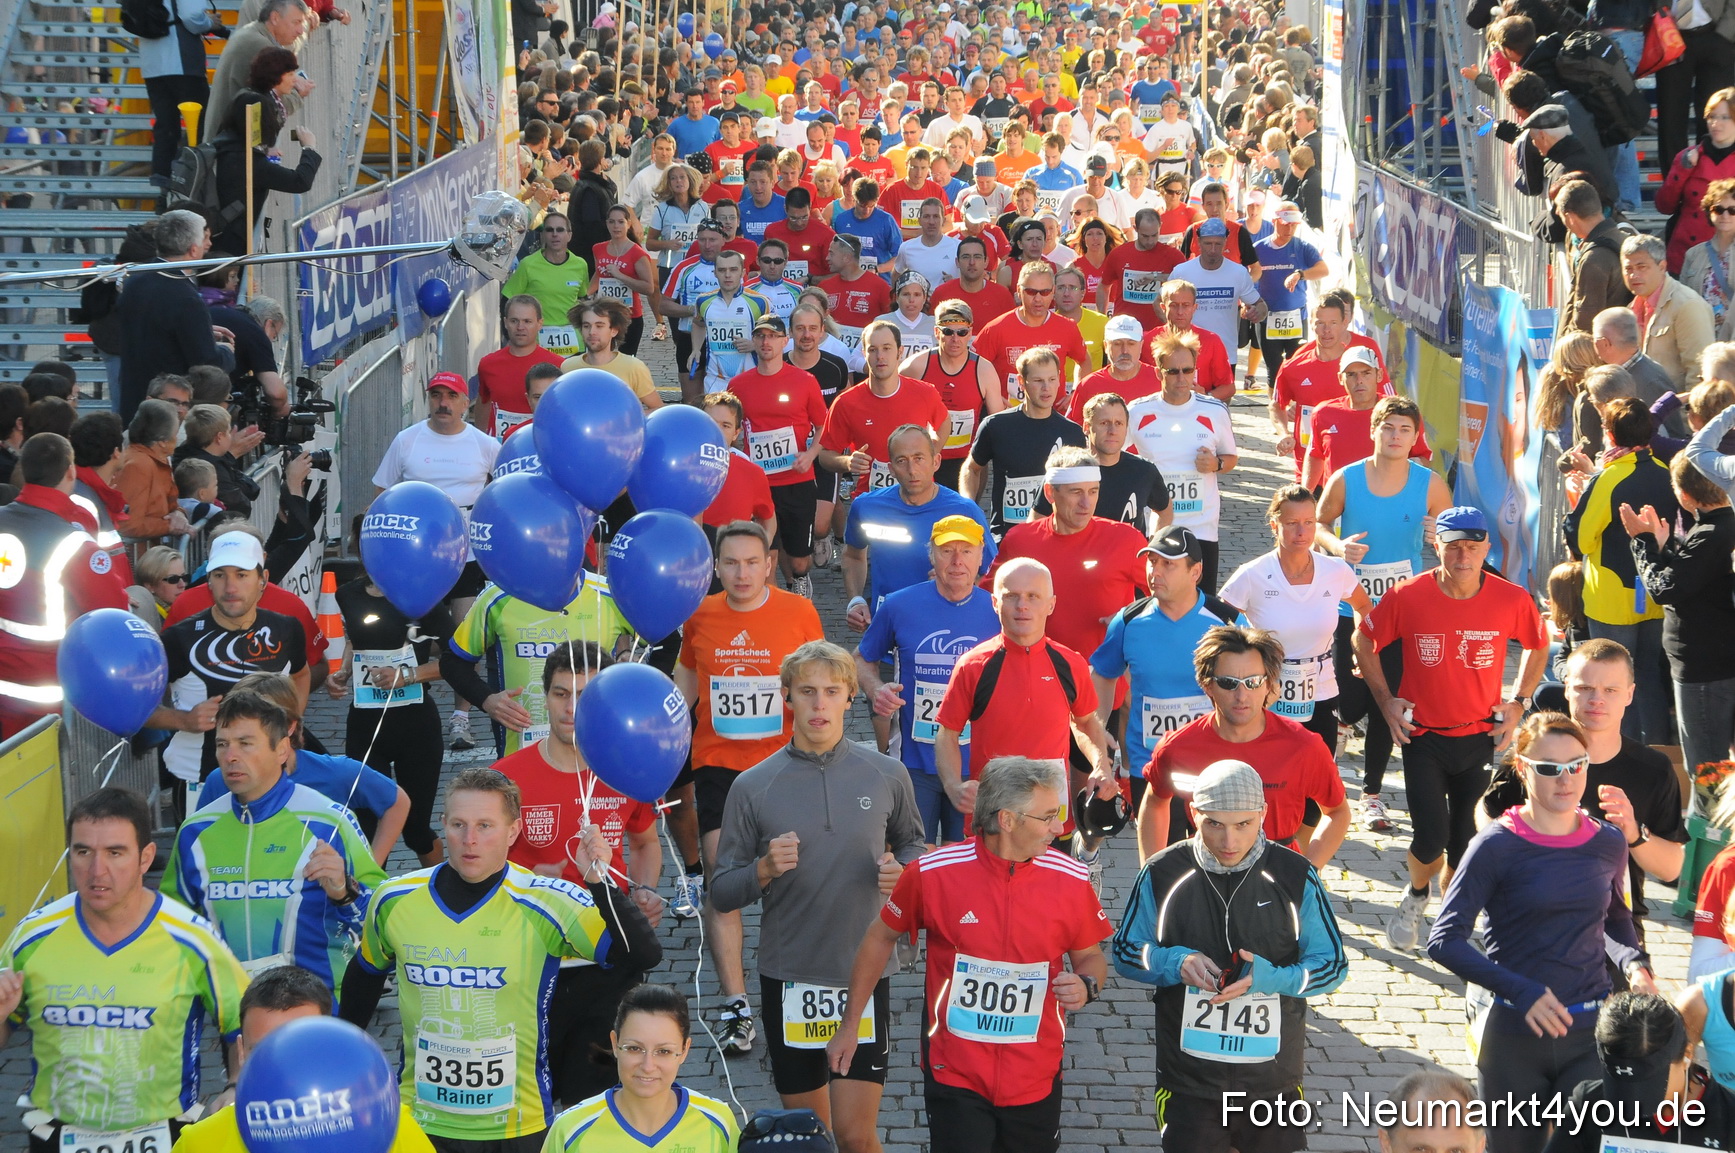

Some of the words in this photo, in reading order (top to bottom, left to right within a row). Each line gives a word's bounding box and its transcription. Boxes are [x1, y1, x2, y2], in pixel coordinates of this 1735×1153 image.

[601, 286, 628, 298] 3302
[1129, 292, 1153, 300] Norbert
[1274, 318, 1295, 329] 645
[547, 333, 571, 347] 410
[711, 328, 744, 342] 3045
[717, 342, 737, 350] Vikto
[754, 438, 791, 460] 3167
[763, 458, 788, 470] Ralph
[1013, 508, 1031, 518] Tob
[361, 514, 421, 532] BOCK
[516, 627, 569, 640] TEAM
[516, 642, 556, 658] BO
[715, 648, 771, 657] SportScheck
[952, 643, 973, 655] FÜR
[915, 665, 951, 676] Maratho
[718, 692, 775, 716] 3517
[524, 817, 555, 825] WIEDER
[527, 825, 553, 835] NEU
[210, 866, 243, 875] TEAM
[207, 878, 295, 900] BOCK
[402, 943, 467, 963] TEAM
[404, 962, 508, 990] BOCK
[969, 963, 1011, 978] PFLEIDERER
[44, 984, 117, 1001] TEAM
[958, 978, 1036, 1014] 3061
[41, 1004, 158, 1030] BOCK
[976, 1013, 1015, 1033] Willi
[1193, 998, 1272, 1035] 2143
[804, 1021, 842, 1038] Mart
[429, 1041, 472, 1055] PFLEIDERER
[1218, 1034, 1245, 1053] Till
[425, 1055, 505, 1088] 3355
[436, 1086, 495, 1106] Rainer
[245, 1087, 352, 1128] BOCK
